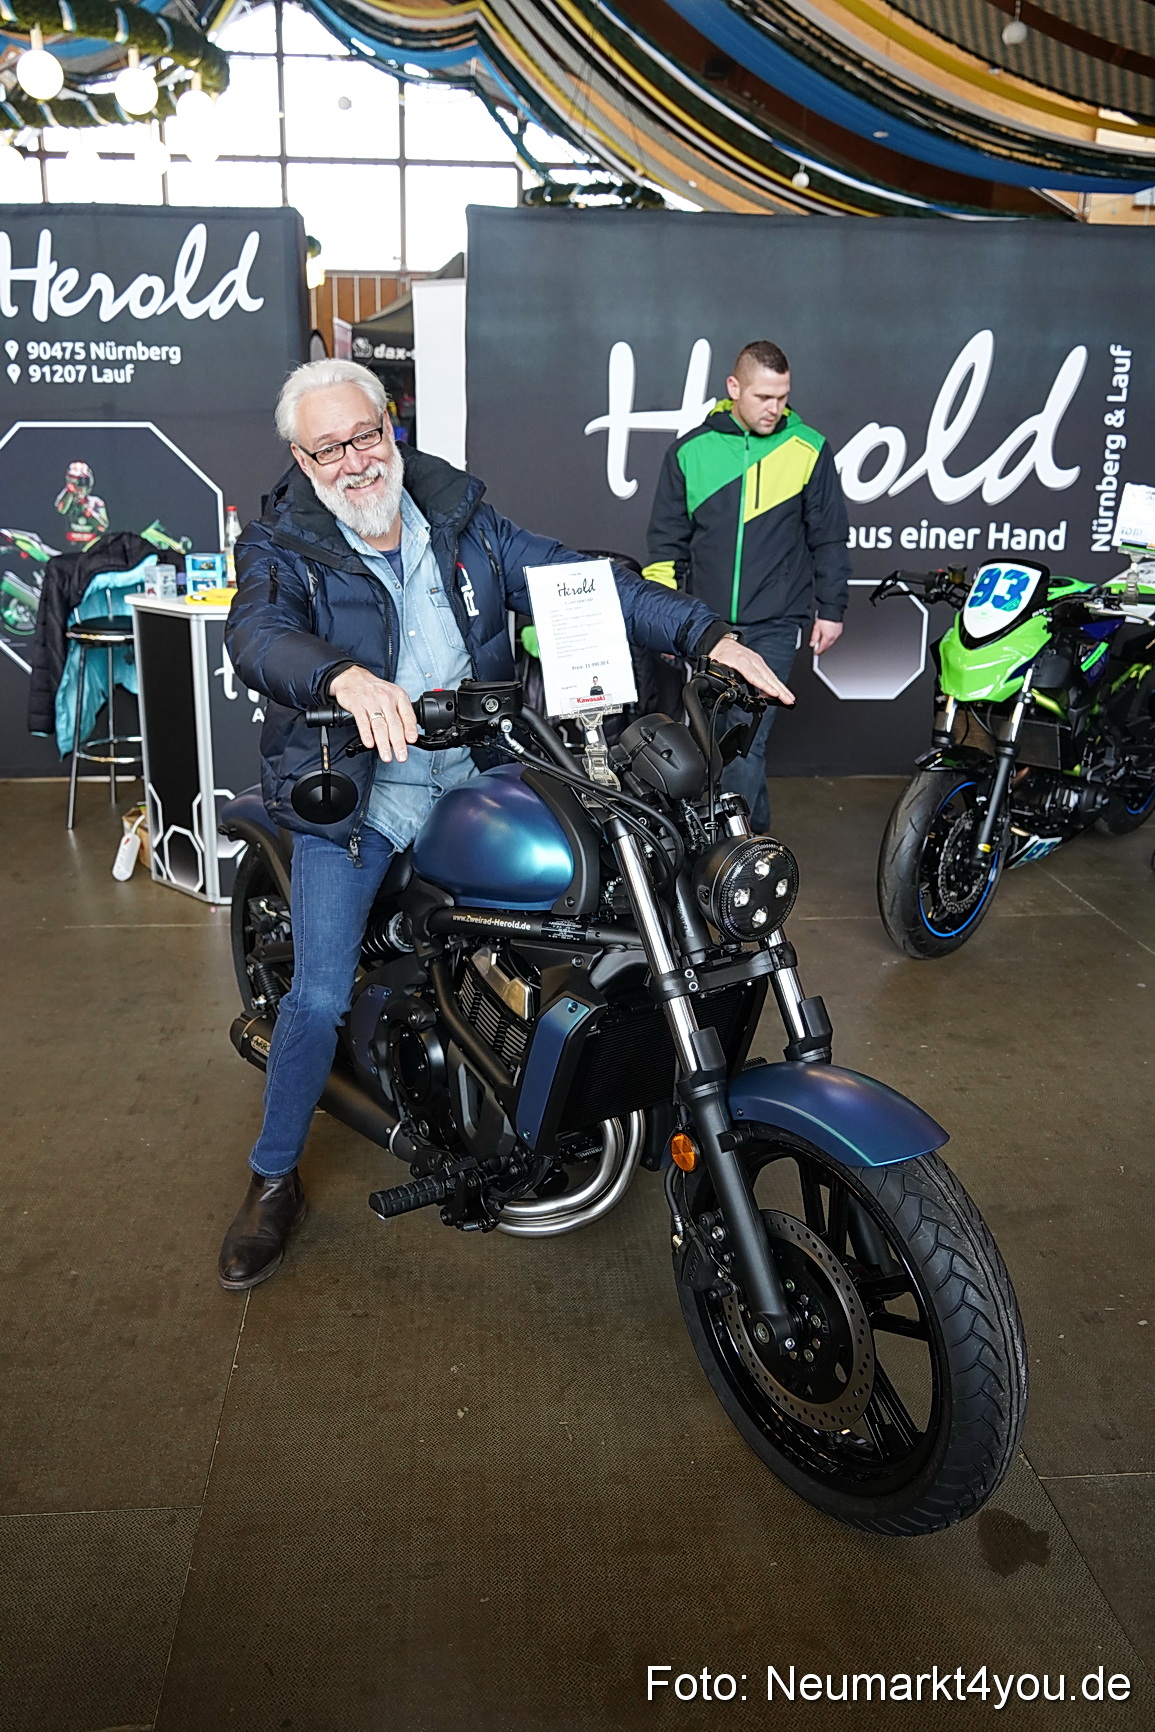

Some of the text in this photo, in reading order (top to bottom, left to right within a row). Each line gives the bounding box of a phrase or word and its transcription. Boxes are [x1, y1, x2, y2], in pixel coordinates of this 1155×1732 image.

[0, 223, 264, 322] Herold
[26, 341, 181, 365] 90475 Nürnberg
[29, 364, 135, 384] 91207 Lauf
[585, 329, 1088, 507] Hold
[1091, 344, 1132, 552] Nürnberg & Lauf
[901, 519, 981, 550] einer
[987, 520, 1067, 551] Hand
[968, 567, 1030, 612] 93
[576, 694, 606, 705] Kawasaki
[452, 914, 531, 931] www.Zweirad-Herold.de
